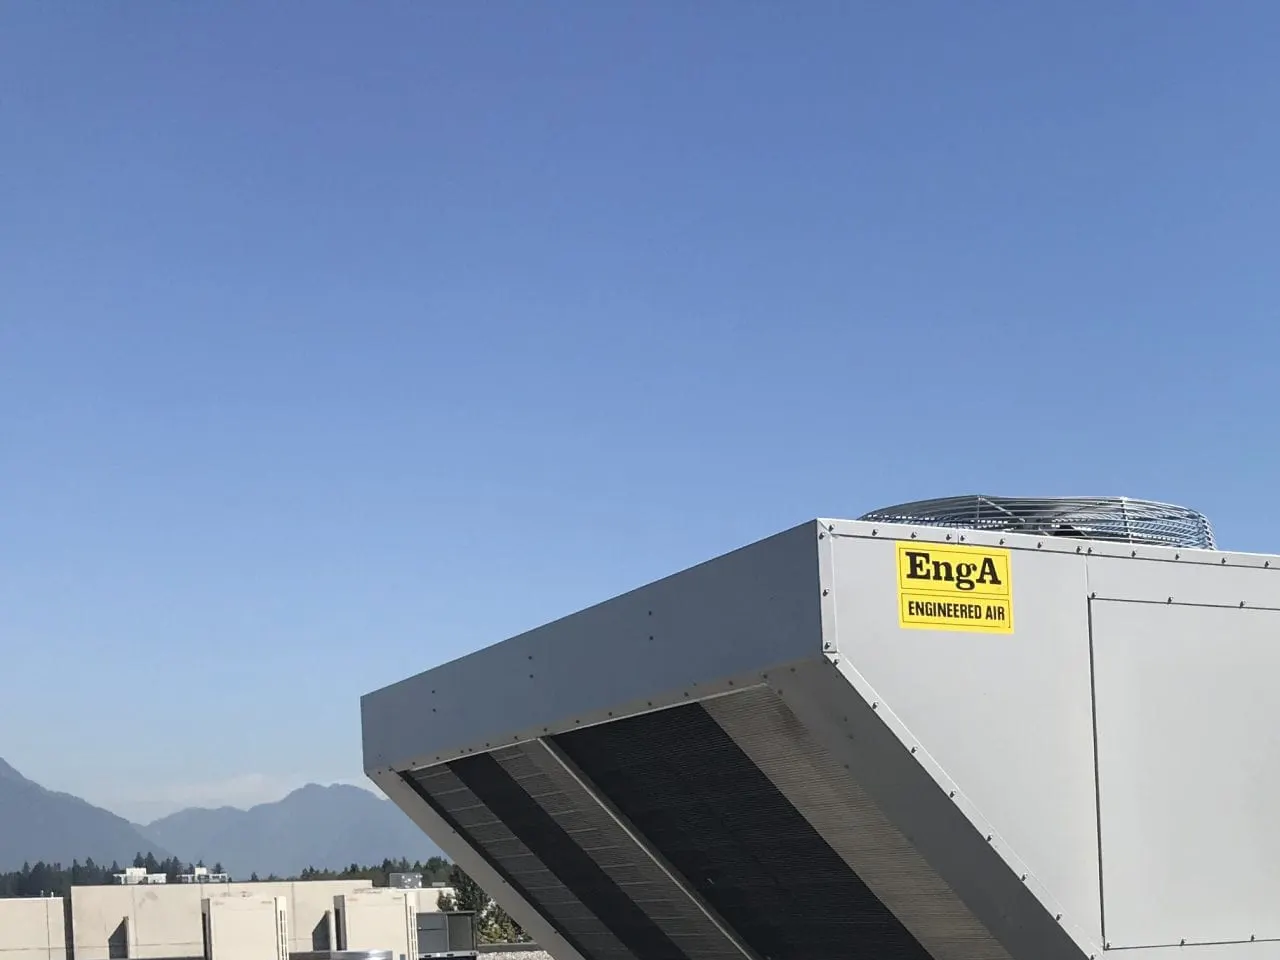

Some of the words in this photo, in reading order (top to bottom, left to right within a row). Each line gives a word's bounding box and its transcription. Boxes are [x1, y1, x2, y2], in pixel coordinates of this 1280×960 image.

[905, 551, 1002, 590] EngA
[908, 600, 982, 619] ENGINEERED
[985, 605, 1005, 621] AIR
